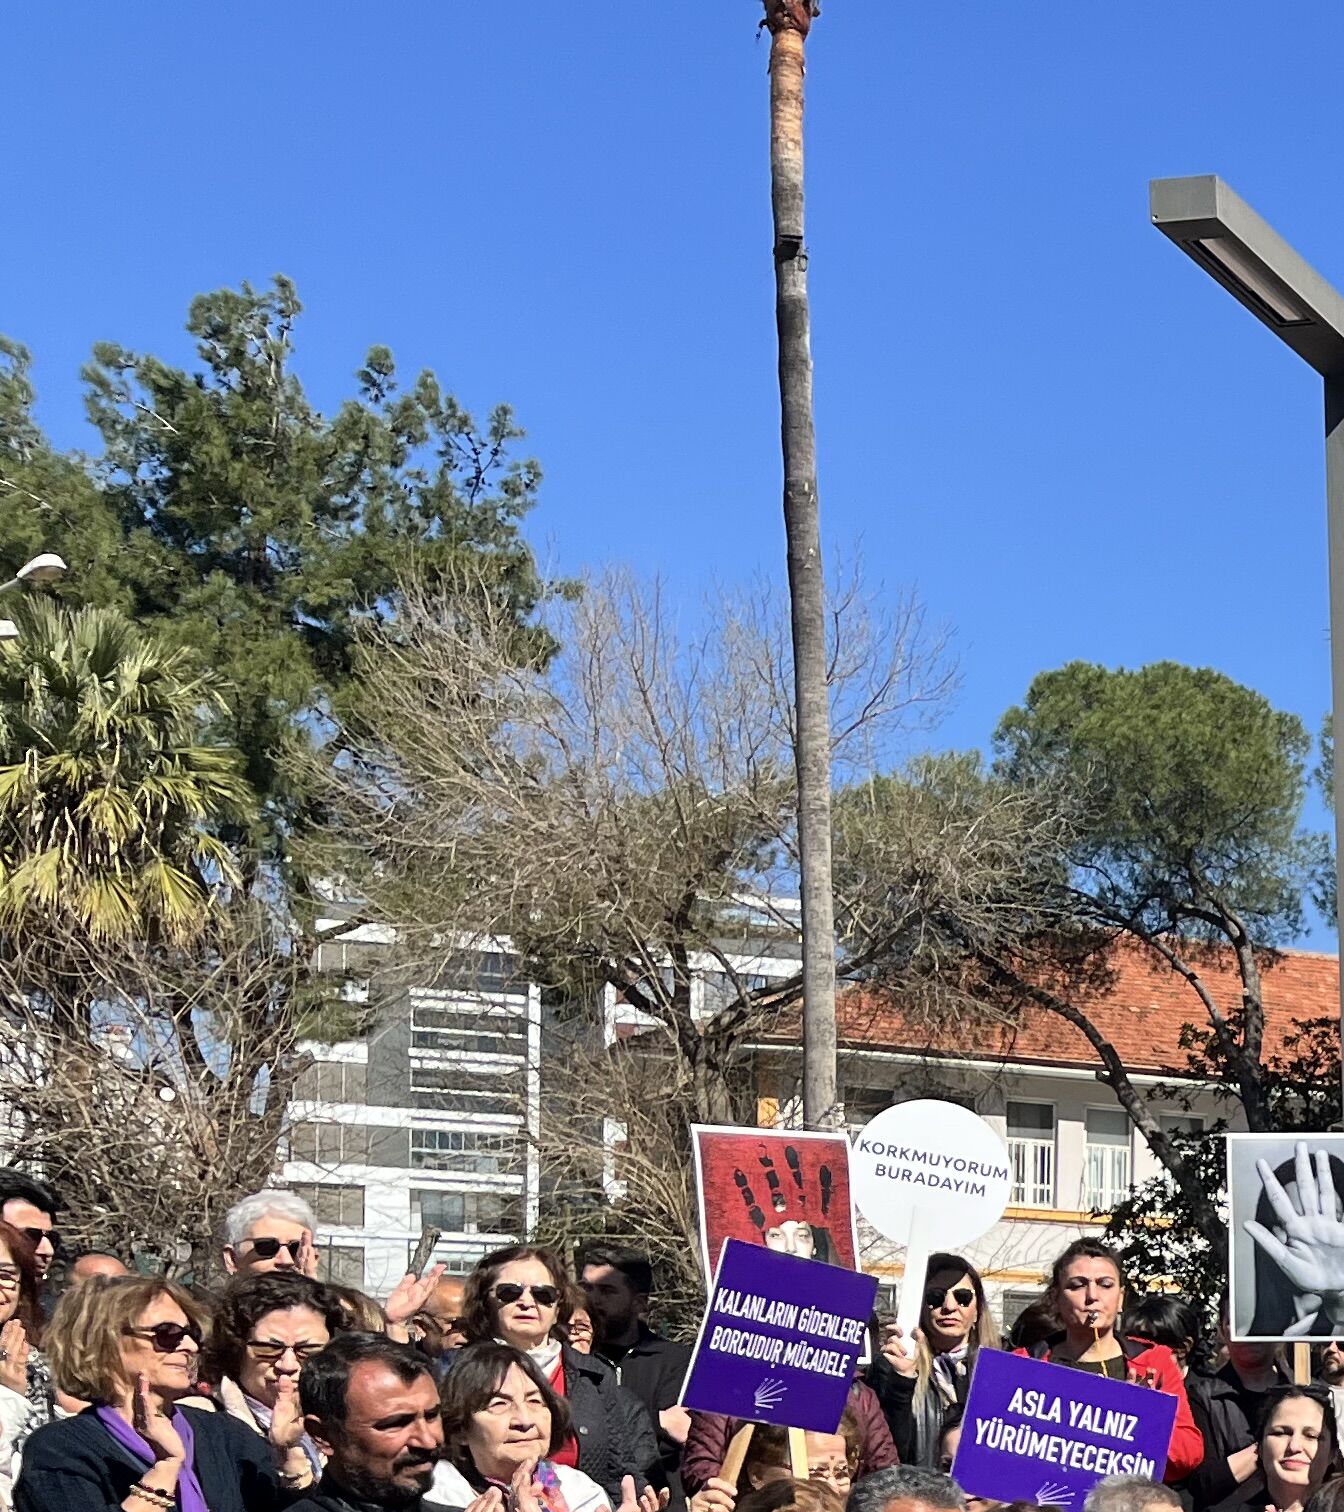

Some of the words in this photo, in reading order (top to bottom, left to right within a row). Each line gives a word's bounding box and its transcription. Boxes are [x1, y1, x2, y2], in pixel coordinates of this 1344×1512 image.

[859, 1139, 1009, 1182] KORKMUYORUM
[874, 1163, 987, 1197] BURADAYIM
[714, 1287, 798, 1330] KALANLARIN
[798, 1305, 865, 1345] GİDENLERE
[710, 1325, 783, 1364] BORCUDUR
[784, 1338, 851, 1378] MÜCADELE
[1007, 1387, 1061, 1424] ASLA
[1069, 1401, 1139, 1442] YALNIZ
[975, 1417, 1155, 1481] YÜRÜMEYECEKSİN
